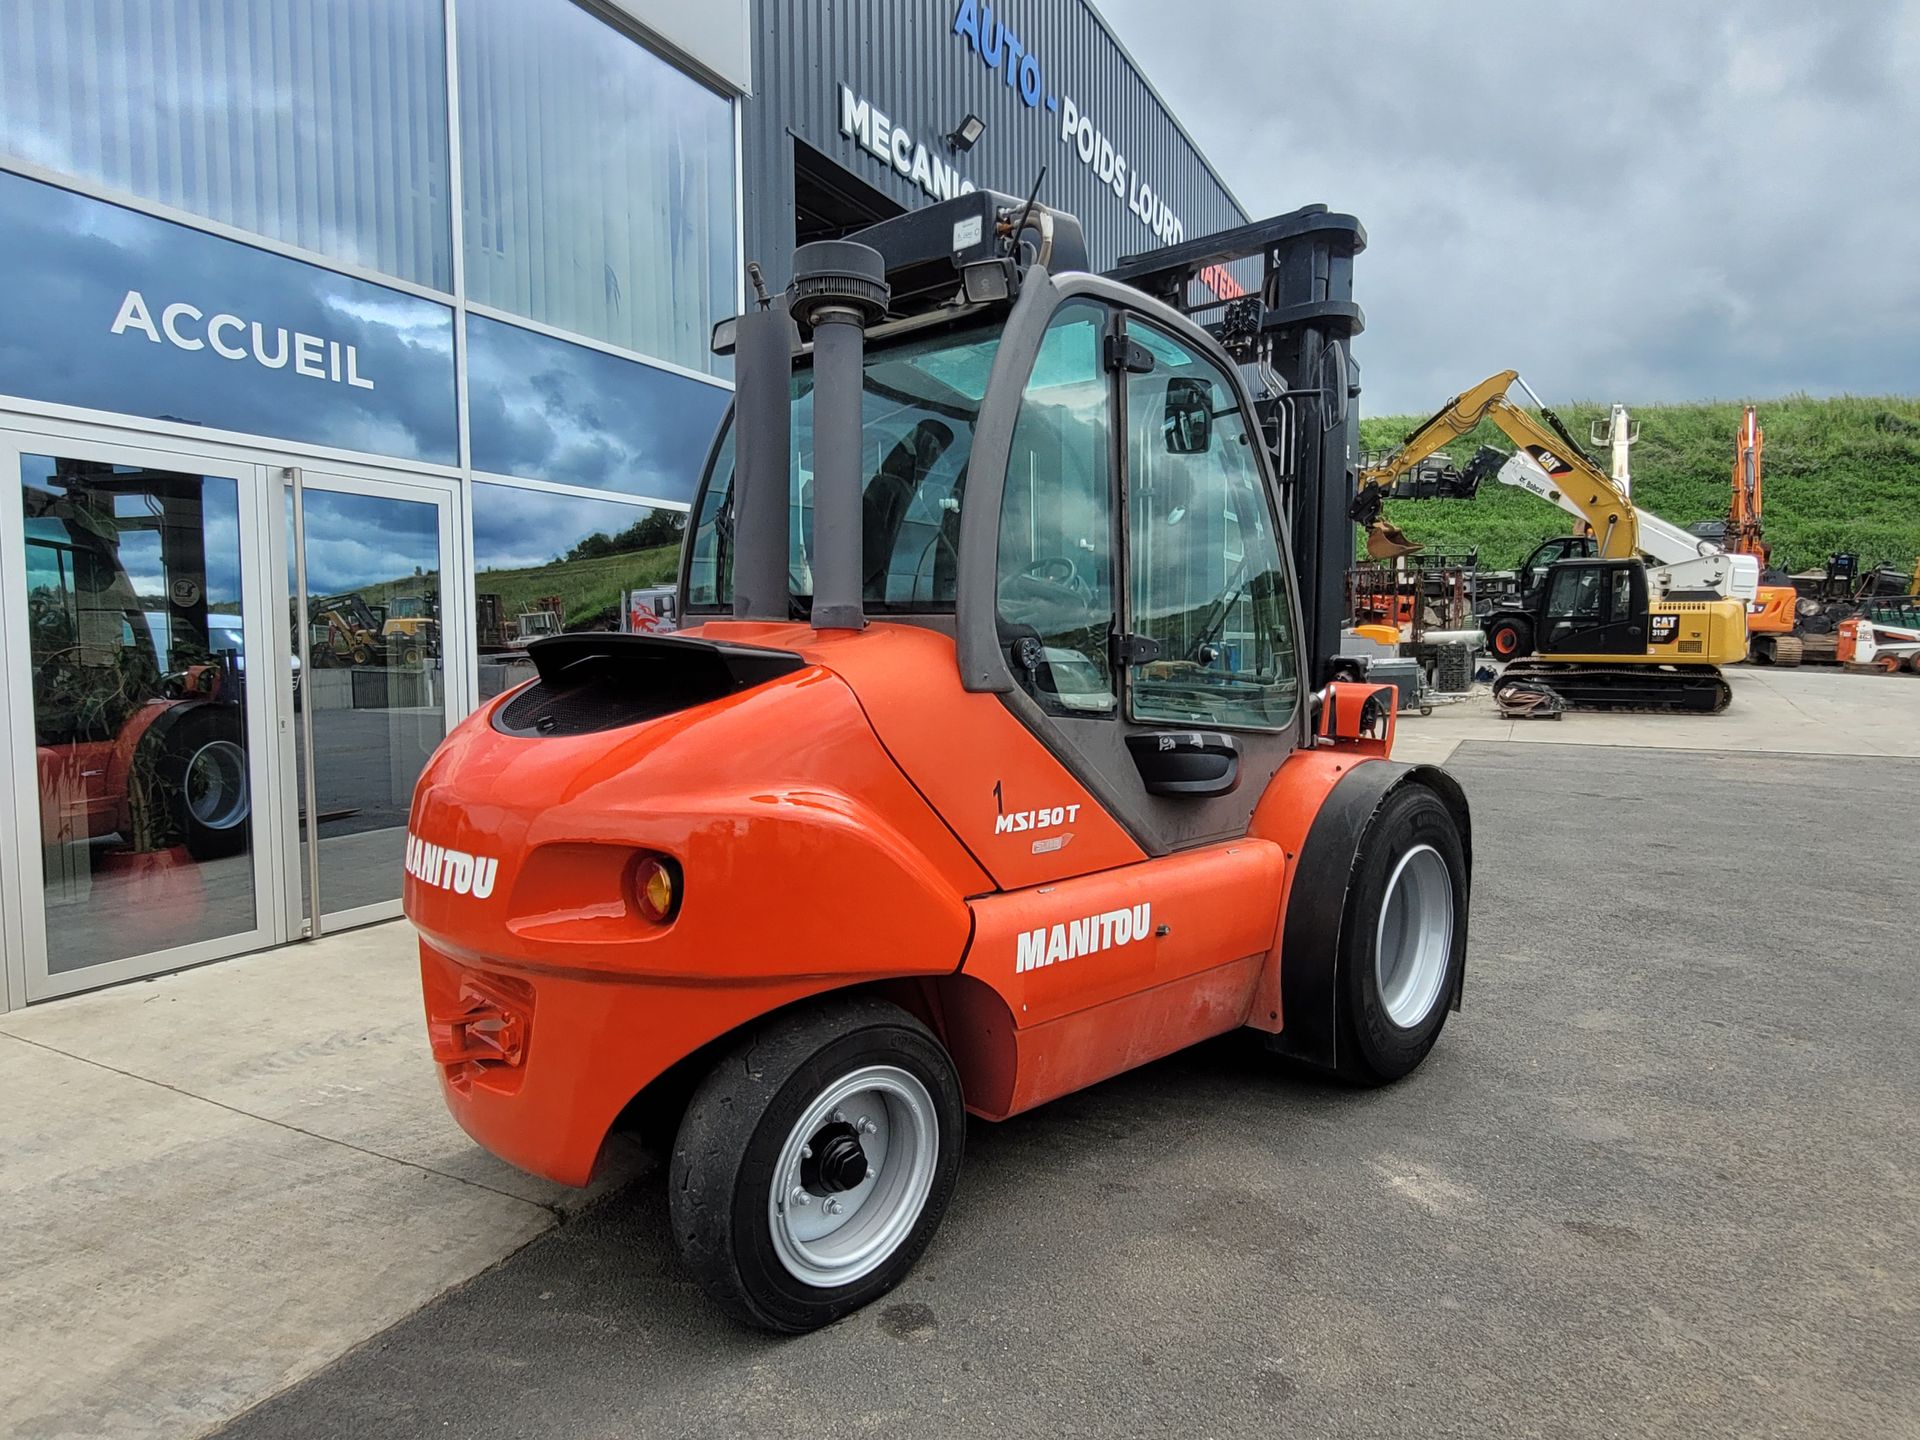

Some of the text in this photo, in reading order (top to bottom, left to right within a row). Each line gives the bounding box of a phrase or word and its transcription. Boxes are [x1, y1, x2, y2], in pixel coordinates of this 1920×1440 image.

[954, 0, 1041, 107] AUTO
[1061, 96, 1127, 198] POIDS
[110, 290, 375, 390] ACCUEIL
[1538, 451, 1561, 472] CAT
[1525, 480, 1546, 496] Bobcat
[1652, 616, 1678, 628] CAT
[1015, 902, 1151, 974] MANITOU
